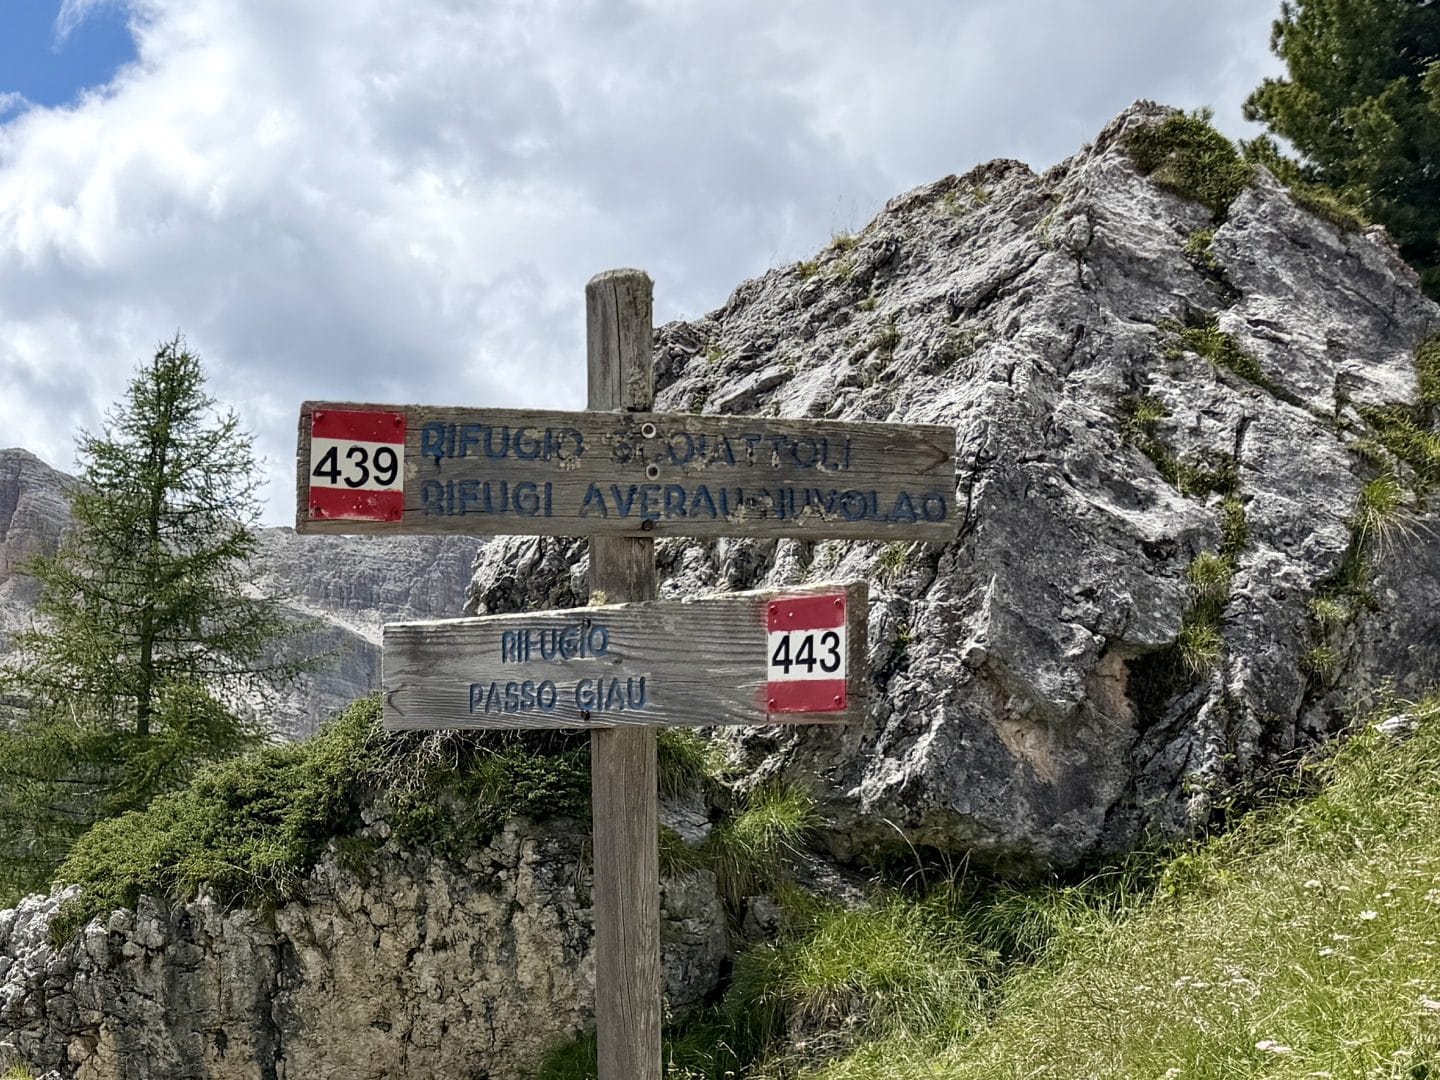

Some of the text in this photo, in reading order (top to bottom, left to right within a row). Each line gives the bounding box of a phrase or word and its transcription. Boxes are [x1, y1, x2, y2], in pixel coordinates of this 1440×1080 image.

[420, 420, 584, 463] RIFUGIO
[312, 446, 399, 488] 439
[420, 479, 553, 518] RIFUGI
[501, 624, 609, 663] RIFUGIO
[771, 631, 841, 675] 443
[469, 676, 647, 713] PASSO GIAU
